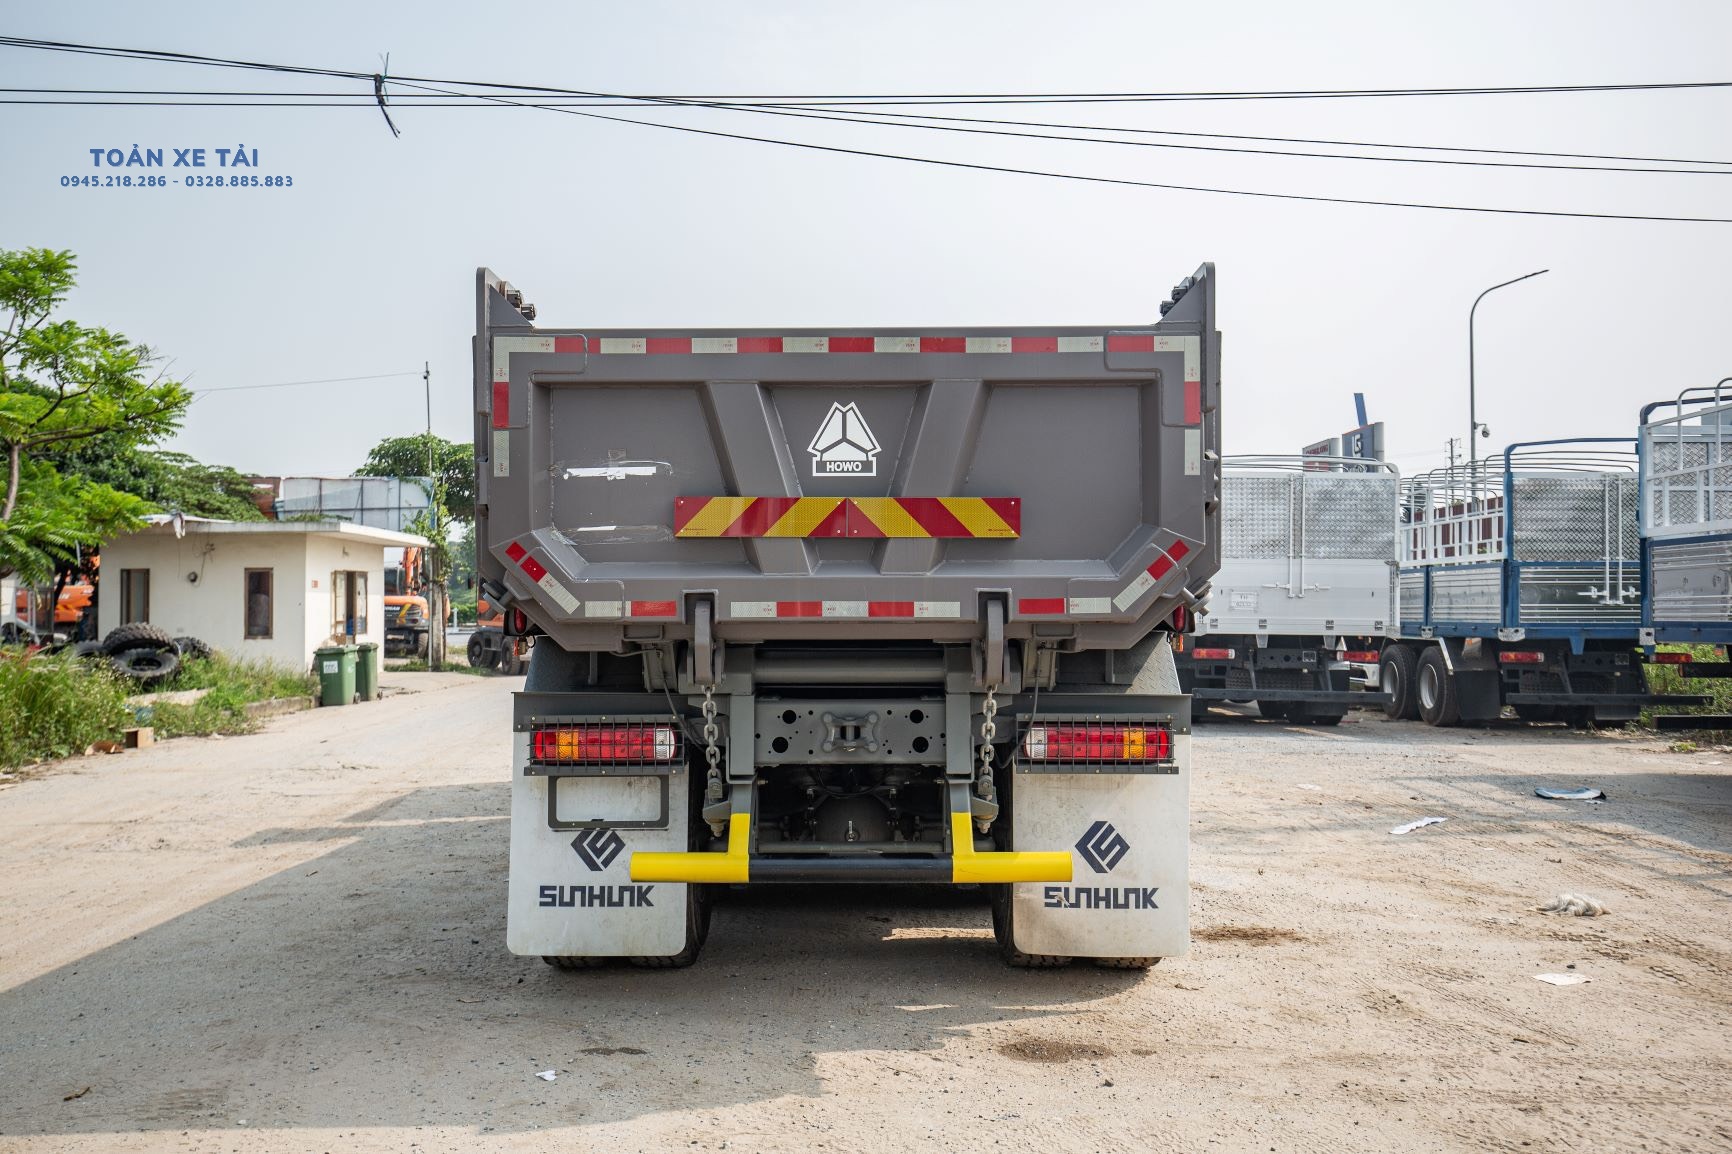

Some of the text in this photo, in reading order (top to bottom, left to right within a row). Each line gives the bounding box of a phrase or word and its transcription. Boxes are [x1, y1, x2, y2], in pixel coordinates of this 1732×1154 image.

[826, 461, 862, 472] HOWO
[539, 885, 655, 907] SUNHUNK
[1044, 886, 1160, 909] SUNHUNK
